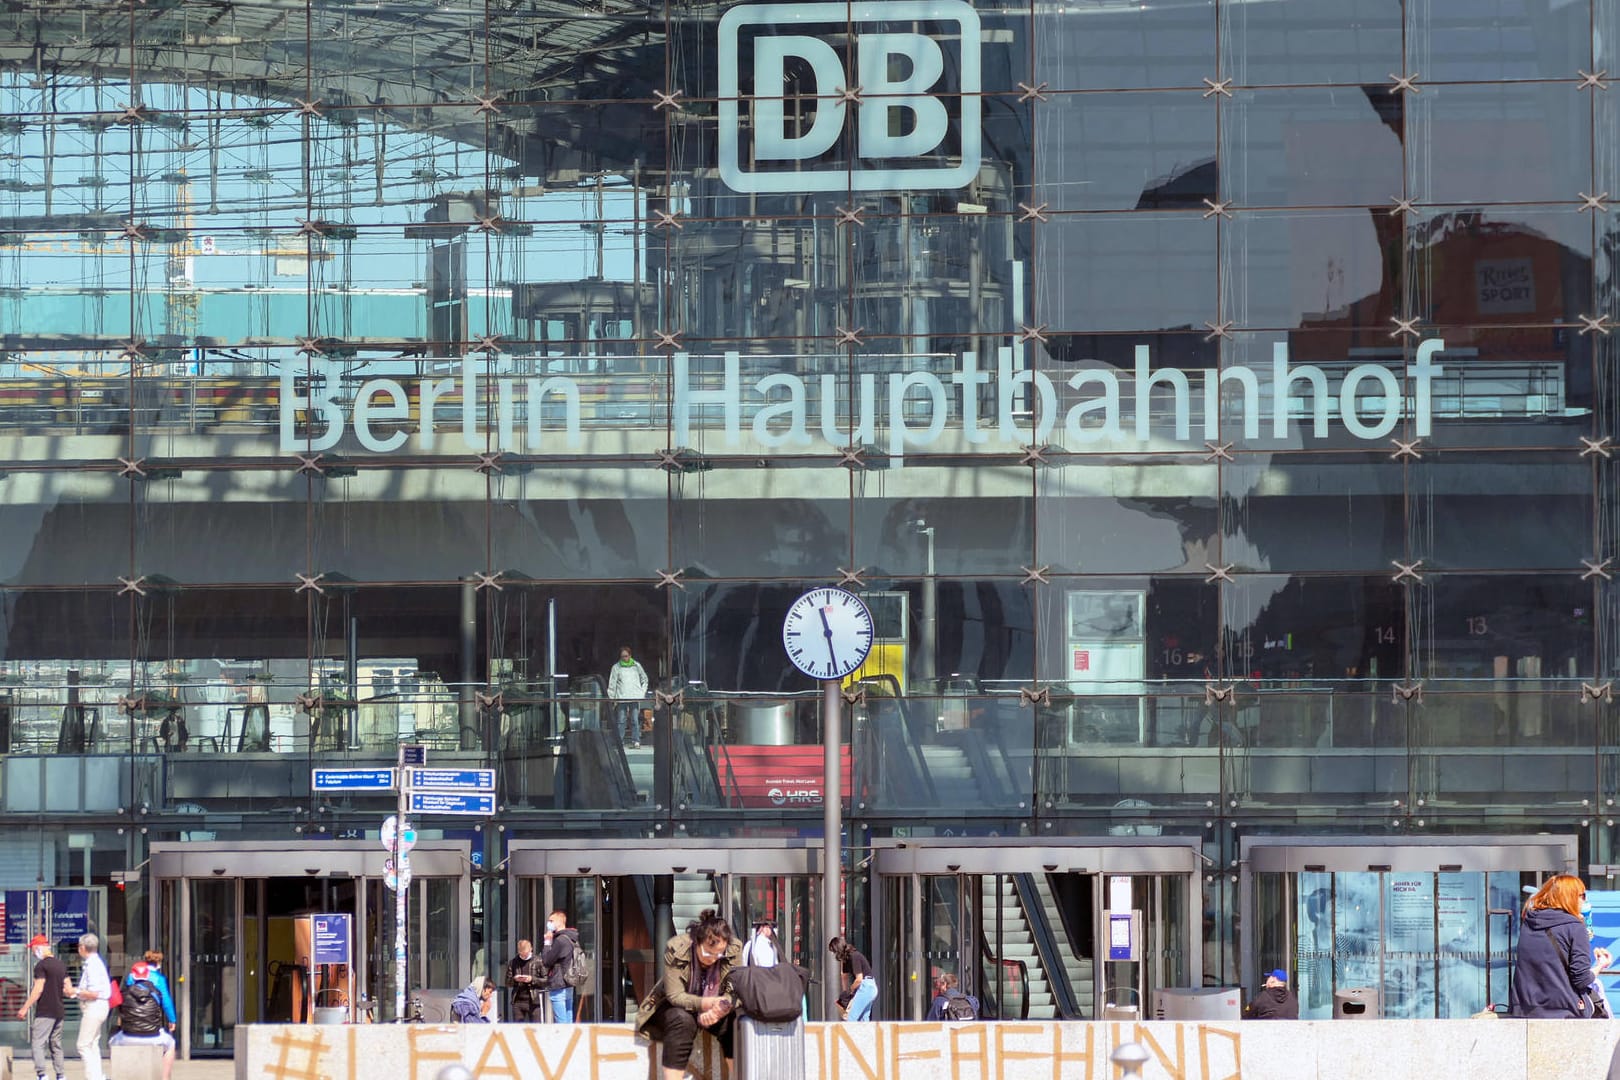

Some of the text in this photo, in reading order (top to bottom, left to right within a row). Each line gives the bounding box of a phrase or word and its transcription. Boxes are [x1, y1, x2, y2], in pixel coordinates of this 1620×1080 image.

[754, 33, 948, 160] DB
[279, 338, 1445, 470] Berlin Hauptbahnhof
[1375, 626, 1395, 644] 14
[1466, 616, 1488, 635] 13
[1163, 649, 1182, 665] 16
